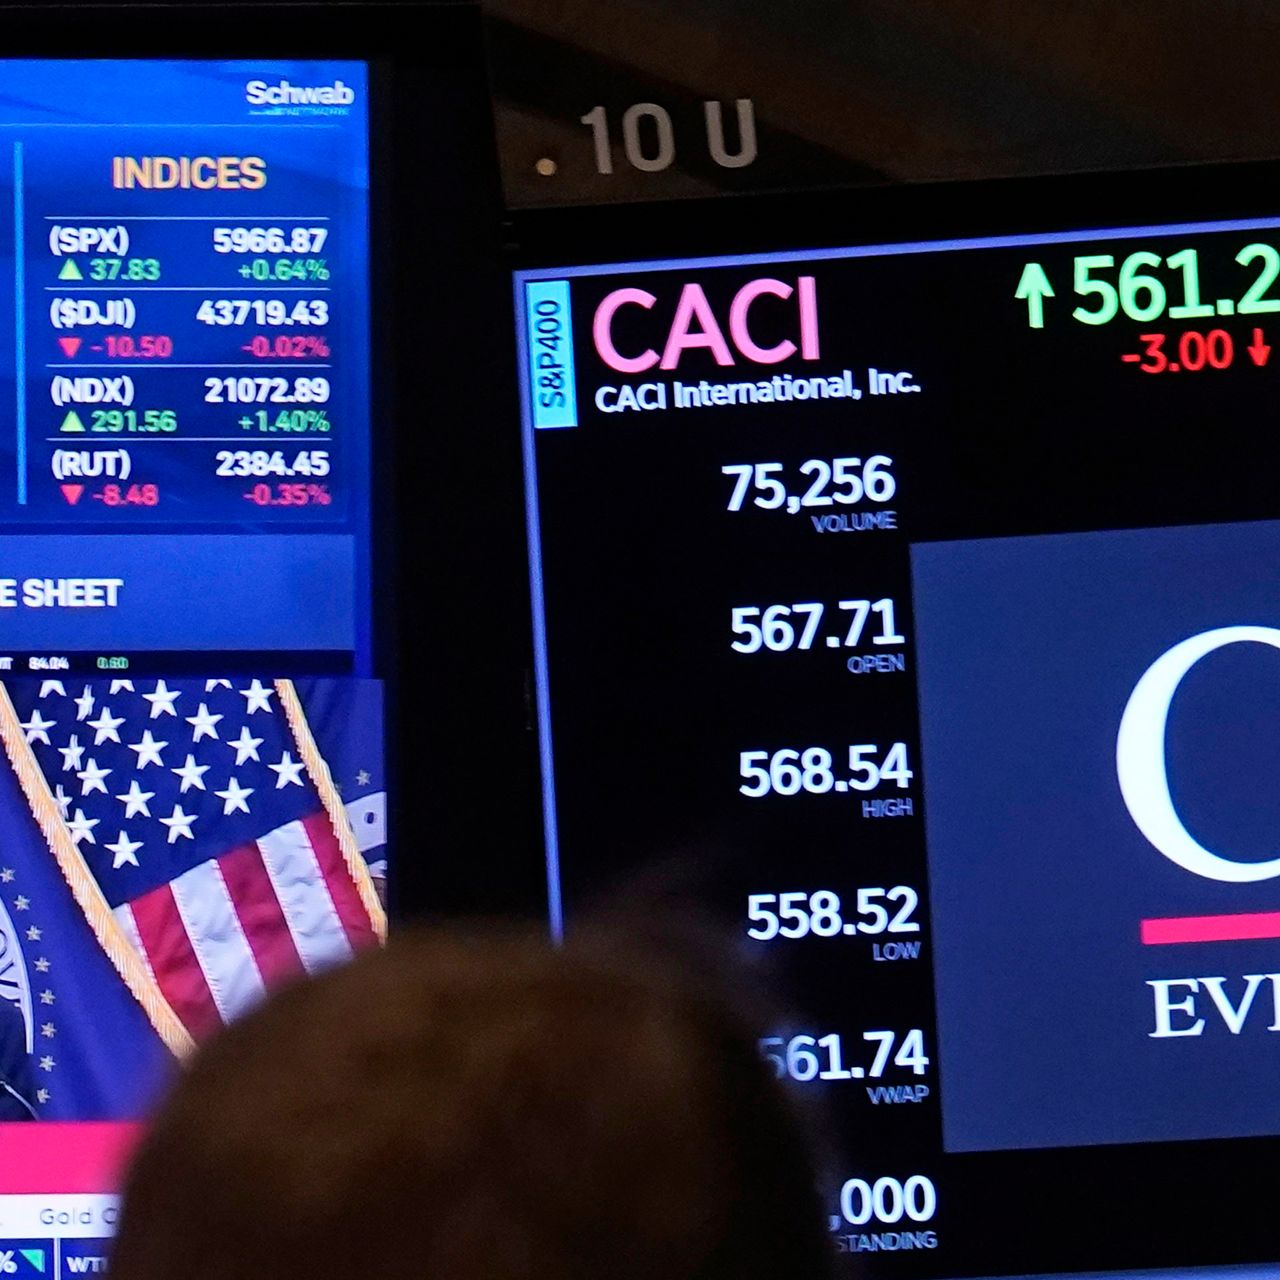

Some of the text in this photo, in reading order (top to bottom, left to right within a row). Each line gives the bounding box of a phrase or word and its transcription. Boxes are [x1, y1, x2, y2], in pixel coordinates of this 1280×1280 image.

[246, 81, 354, 106] Schwab
[581, 99, 757, 176] 10 U
[113, 157, 267, 189] INDICES
[49, 226, 328, 256] (SPX) 5966.87
[592, 276, 821, 374] CACI
[536, 300, 567, 409] S&P400
[51, 376, 330, 406] (NDX) 21072.89
[595, 367, 921, 413] CACI International, Inc.
[722, 456, 896, 513] 75,256
[812, 512, 897, 534] VOLUME
[23, 579, 123, 607] SHEET
[731, 599, 904, 654] 567.71
[848, 654, 904, 674] OPEN
[740, 743, 912, 796] 568.54
[863, 799, 913, 818] HIGH
[748, 887, 919, 940] 558.52
[873, 940, 920, 961] LOW
[39, 1207, 92, 1225] Gold
